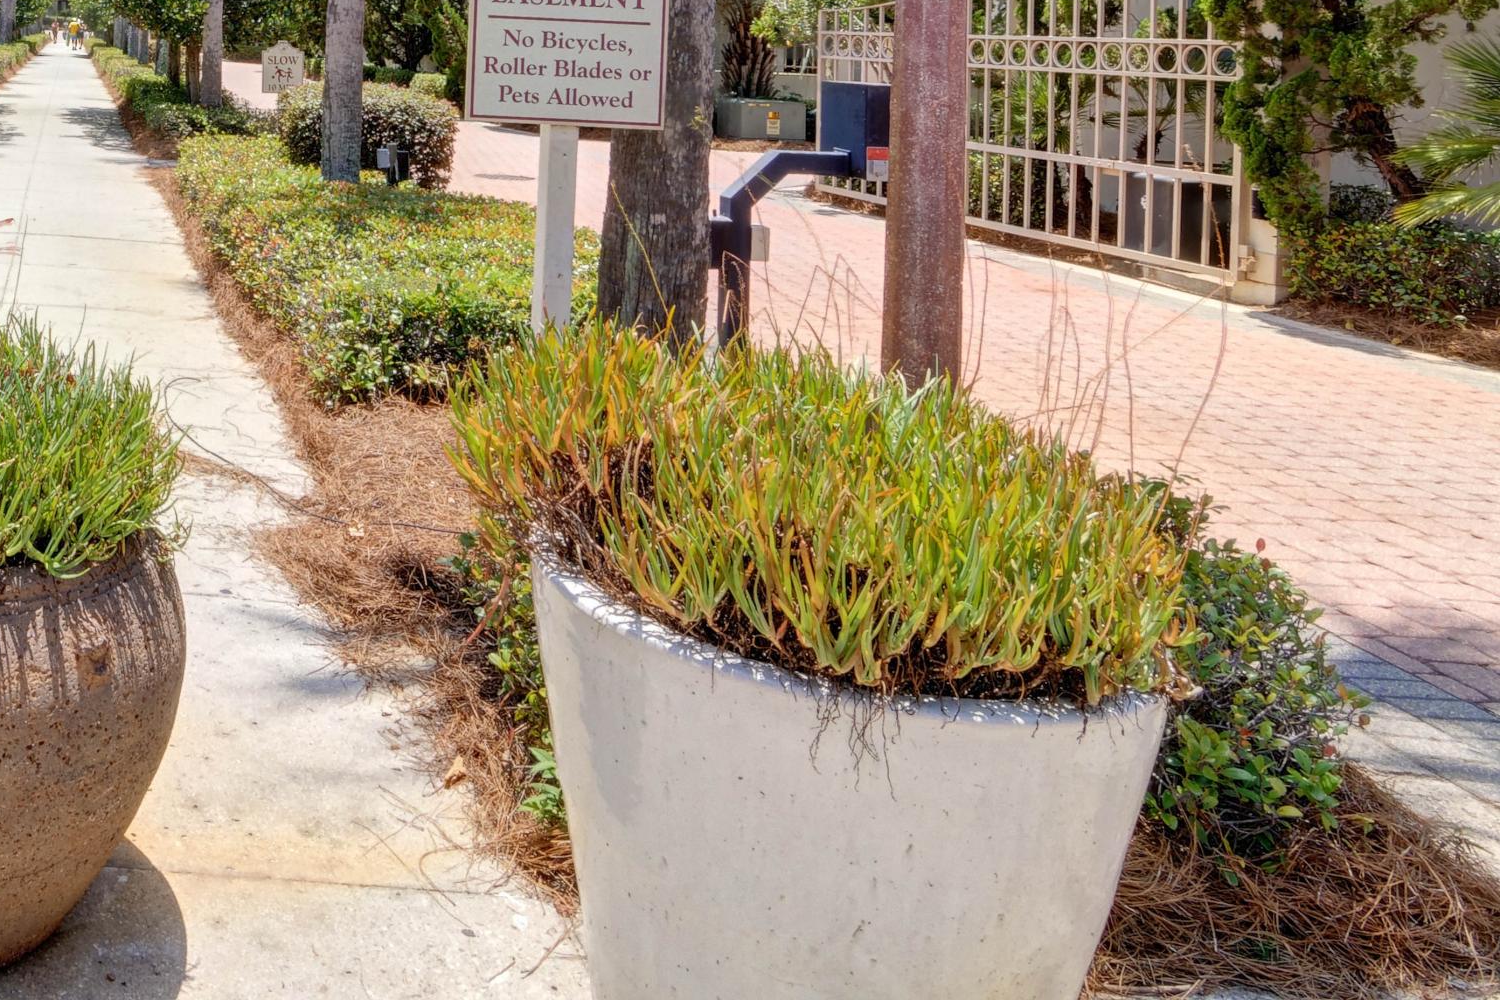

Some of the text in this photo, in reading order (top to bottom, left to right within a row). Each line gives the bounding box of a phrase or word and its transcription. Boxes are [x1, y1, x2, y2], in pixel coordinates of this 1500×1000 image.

[502, 29, 633, 56] No Bicycles,
[267, 55, 300, 65] SLOW
[483, 56, 652, 81] Roller Blades or
[498, 84, 633, 109] Pets Allowed
